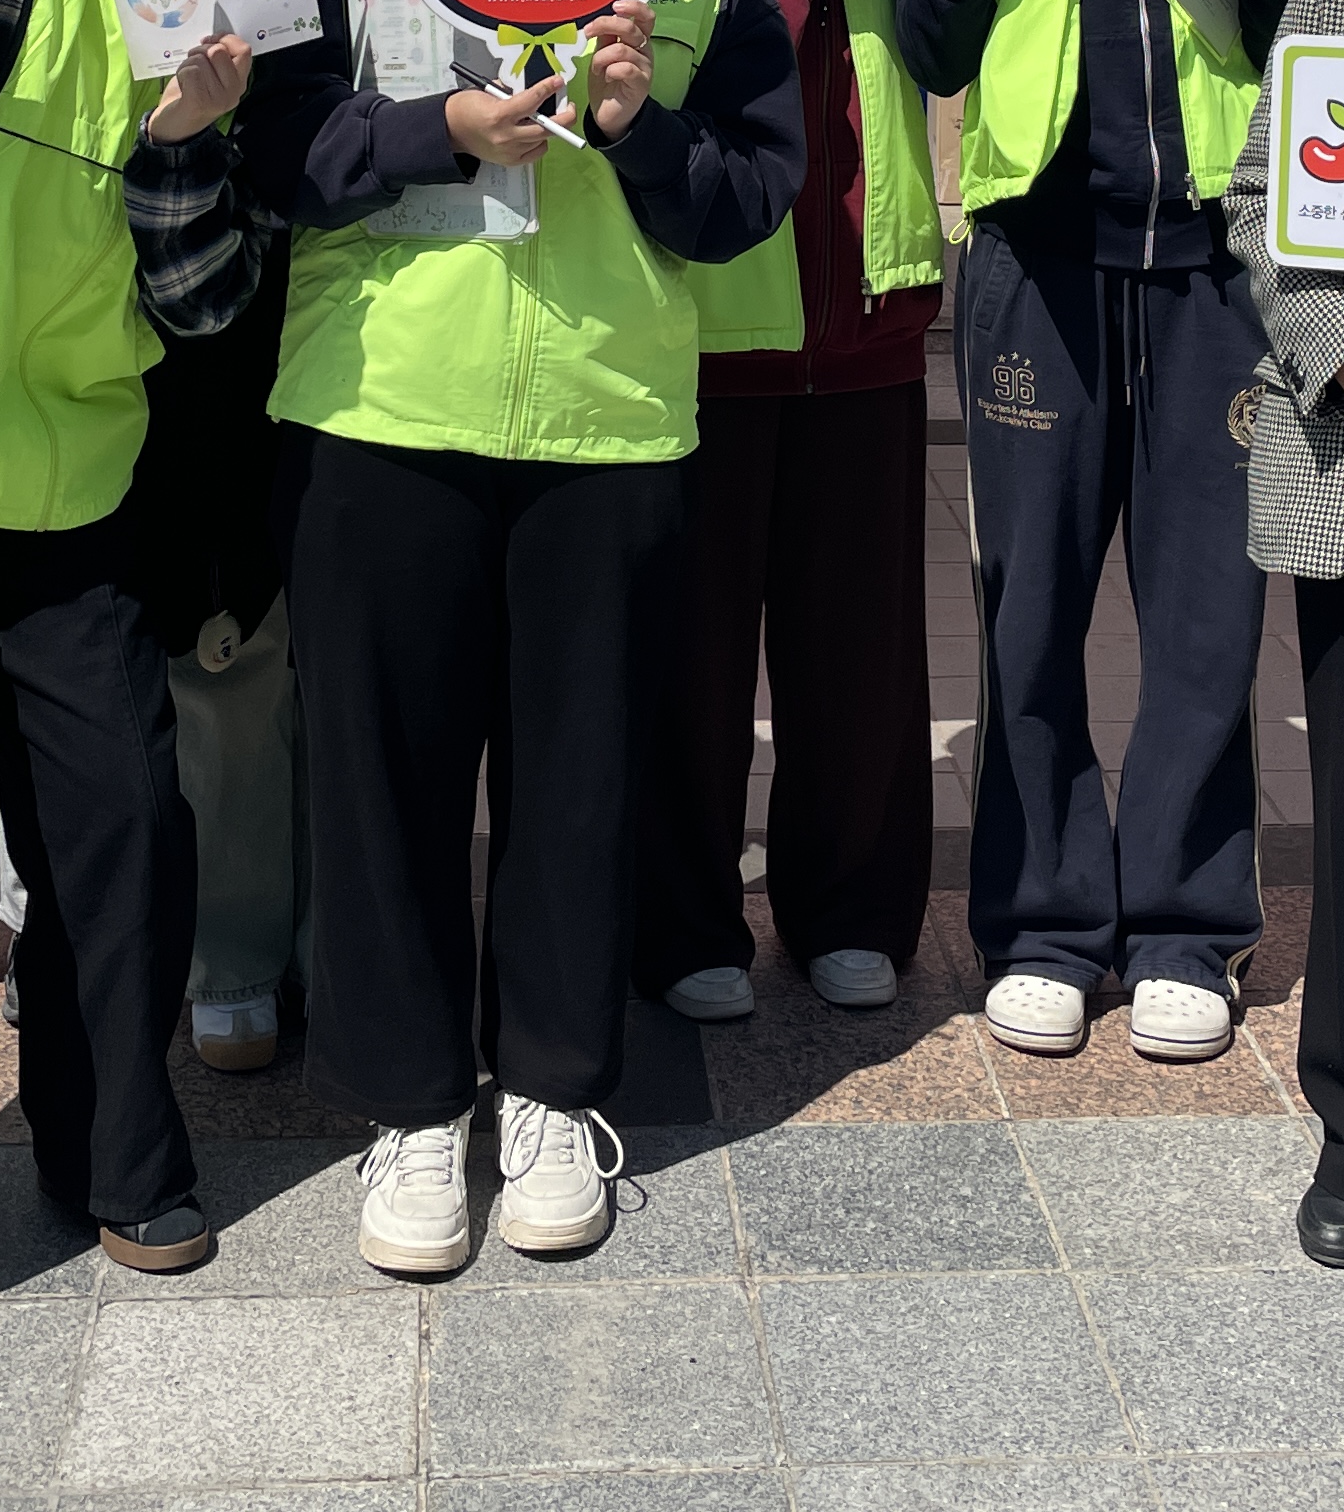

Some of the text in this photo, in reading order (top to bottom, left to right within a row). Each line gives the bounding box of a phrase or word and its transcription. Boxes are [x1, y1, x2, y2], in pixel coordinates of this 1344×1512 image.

[1298, 204, 1337, 220] 소중한
[992, 364, 1036, 406] 96
[1029, 419, 1052, 430] Club
